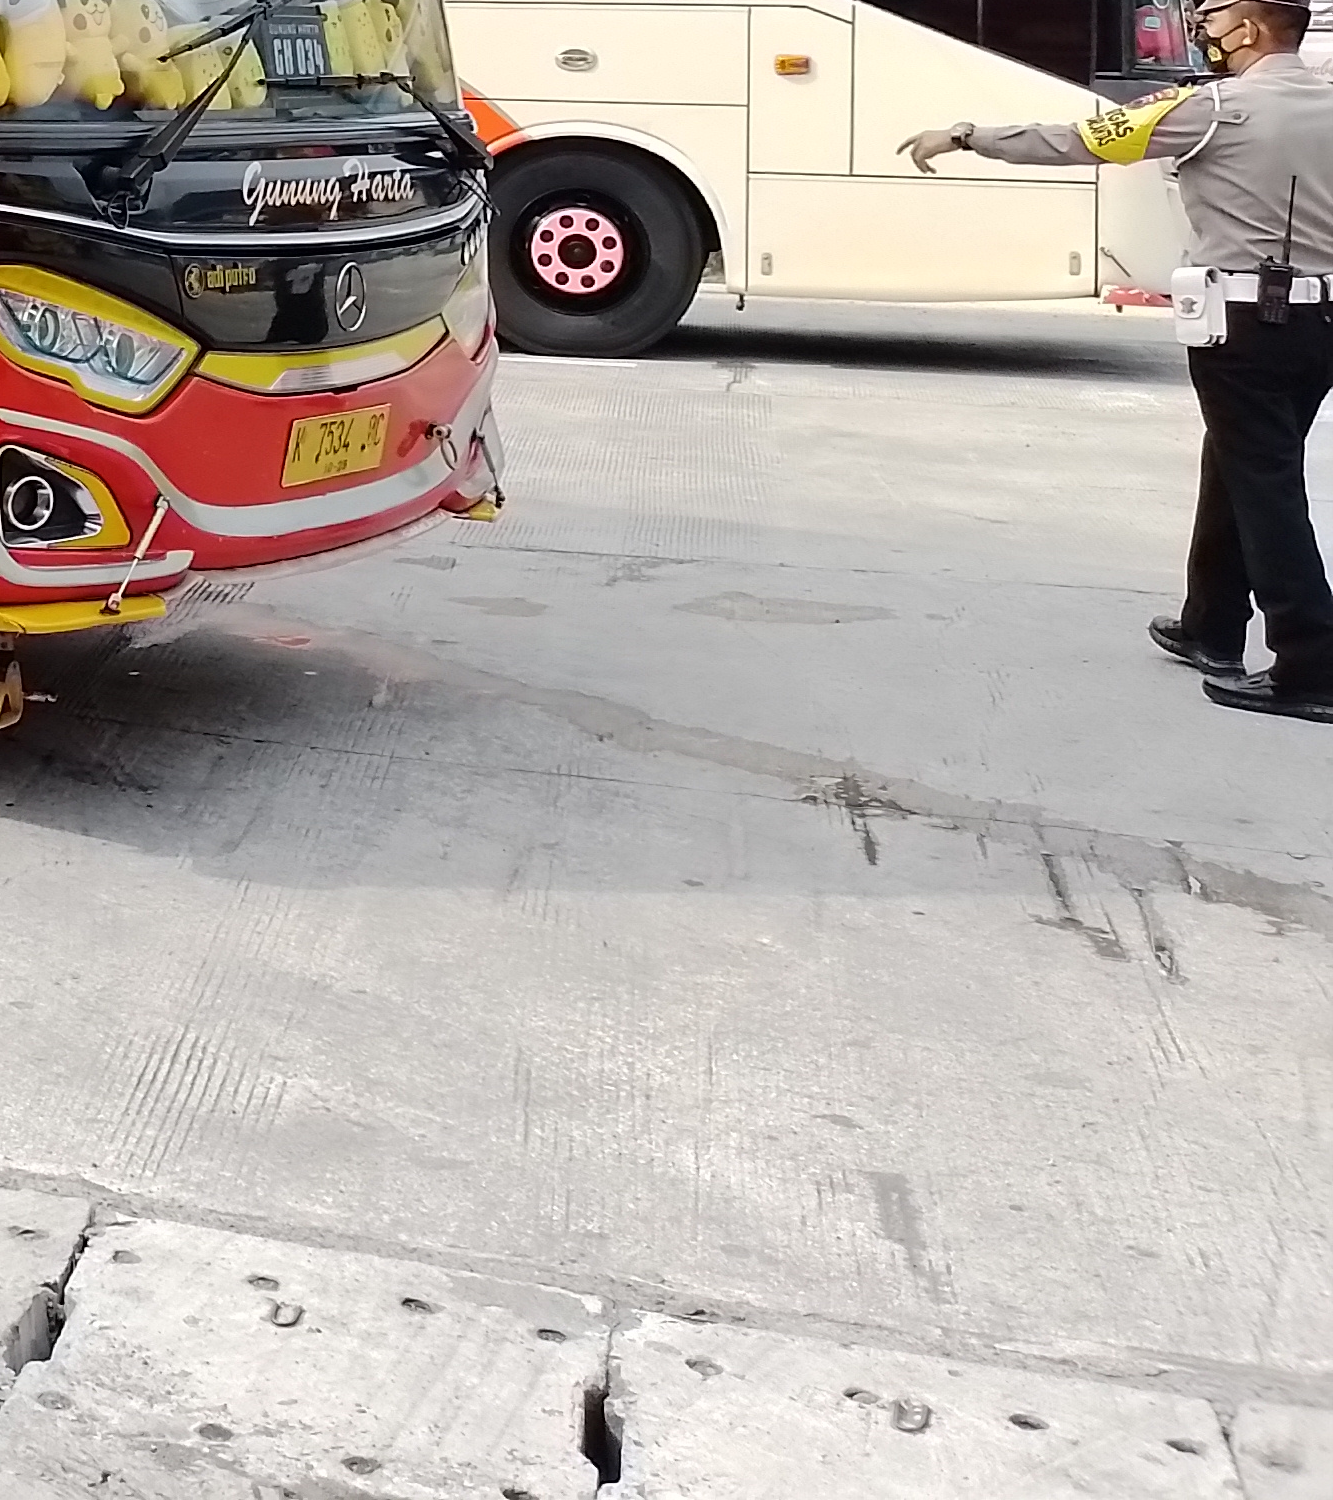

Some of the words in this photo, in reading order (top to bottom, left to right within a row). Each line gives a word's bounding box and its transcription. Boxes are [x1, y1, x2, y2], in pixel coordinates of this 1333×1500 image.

[273, 38, 294, 75] GH
[296, 38, 324, 75] 034
[242, 161, 342, 226] Gunung
[343, 158, 414, 202] Harta
[315, 418, 354, 464] 7534
